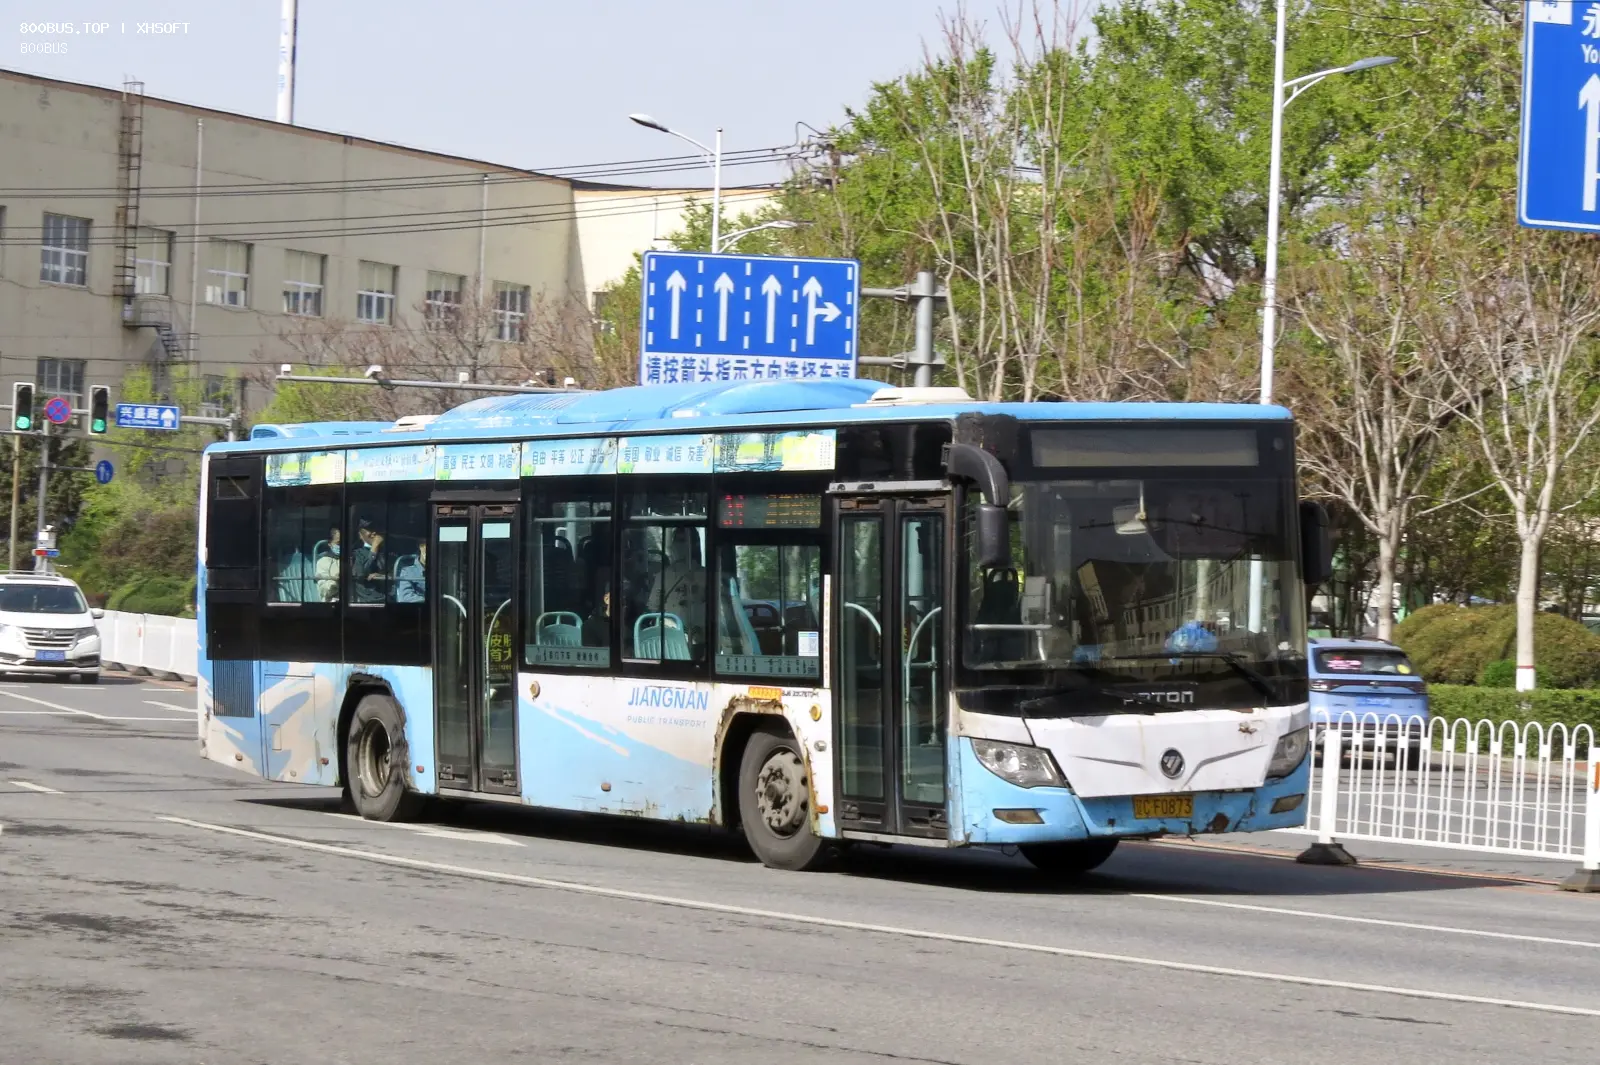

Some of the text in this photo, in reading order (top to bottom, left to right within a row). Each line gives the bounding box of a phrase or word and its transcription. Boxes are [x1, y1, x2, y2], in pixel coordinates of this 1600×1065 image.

[645, 355, 851, 384] 请按箭头指示方向选择车道
[462, 454, 475, 470] 民主
[480, 454, 494, 469] 文明
[532, 451, 546, 465] 自由
[551, 449, 565, 465] 平等
[570, 448, 585, 464] 公正
[624, 445, 704, 462] 爱国 敬业 诚信 友善
[627, 686, 709, 711] JIANGNAN
[627, 715, 707, 728] PUBLIC TRANSPORT
